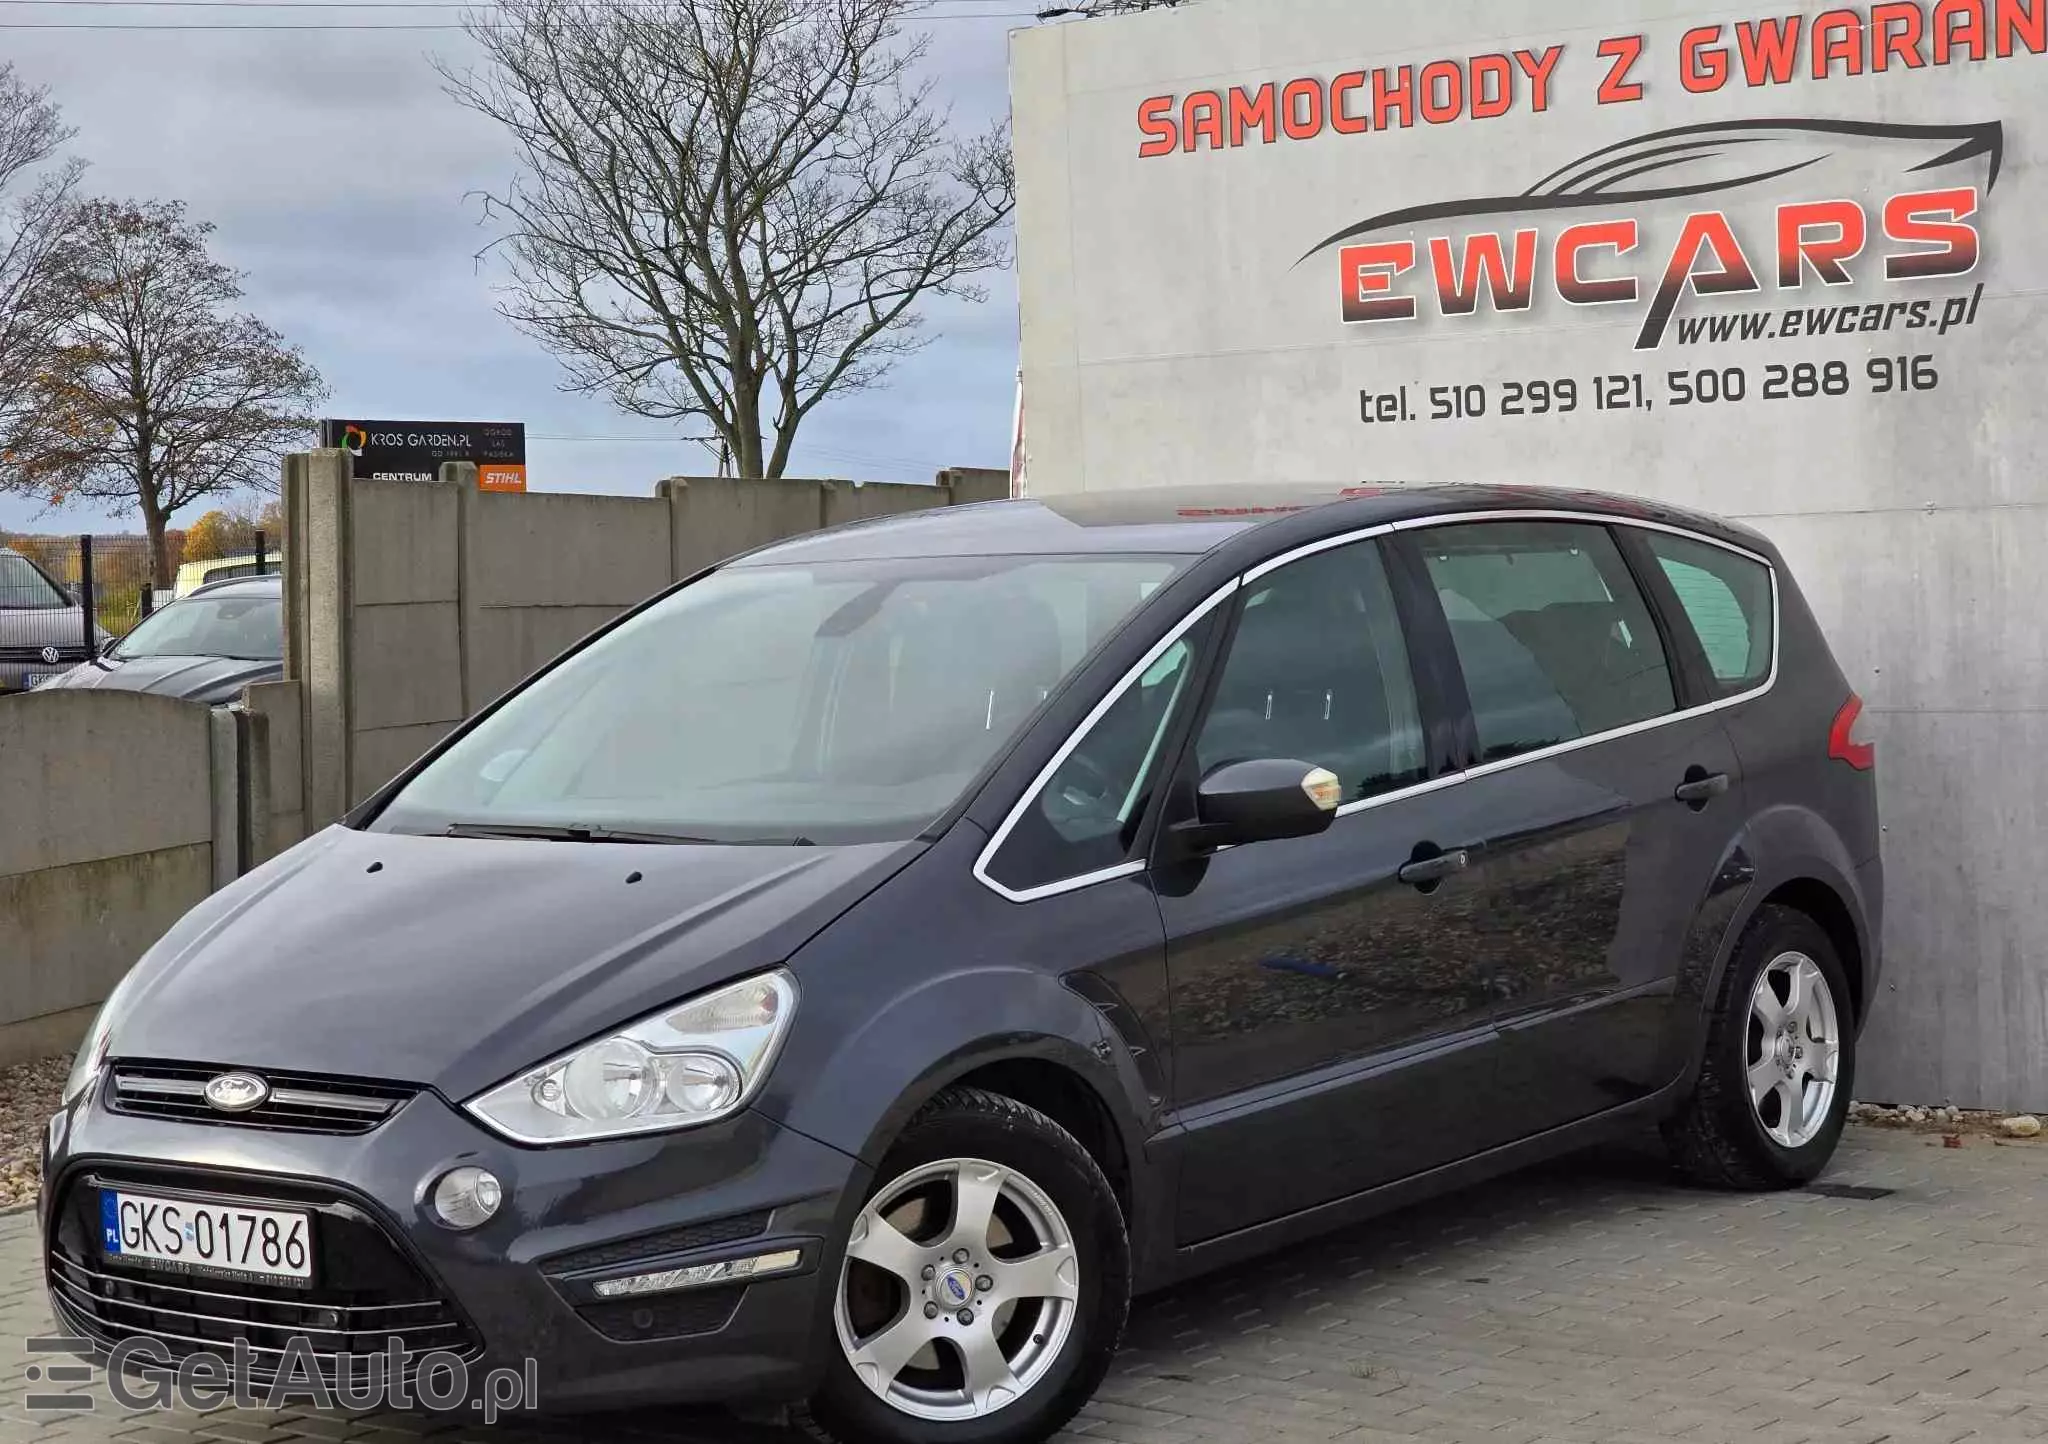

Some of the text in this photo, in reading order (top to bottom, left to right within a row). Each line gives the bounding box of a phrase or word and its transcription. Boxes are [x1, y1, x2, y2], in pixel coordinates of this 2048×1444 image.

[1137, 45, 1566, 159] SAMOCHODY
[1597, 35, 1643, 105] Z
[1338, 187, 1980, 351] EWCARS
[1677, 282, 1985, 345] www.ewcars.pl
[1359, 354, 1938, 423] tel. 510 299 121, 500 288 916
[371, 432, 473, 447] KROS GARDEN.PL
[373, 472, 432, 482] CENTRUM
[485, 472, 522, 485] STIHL
[106, 1201, 305, 1269] PL GKS 01786
